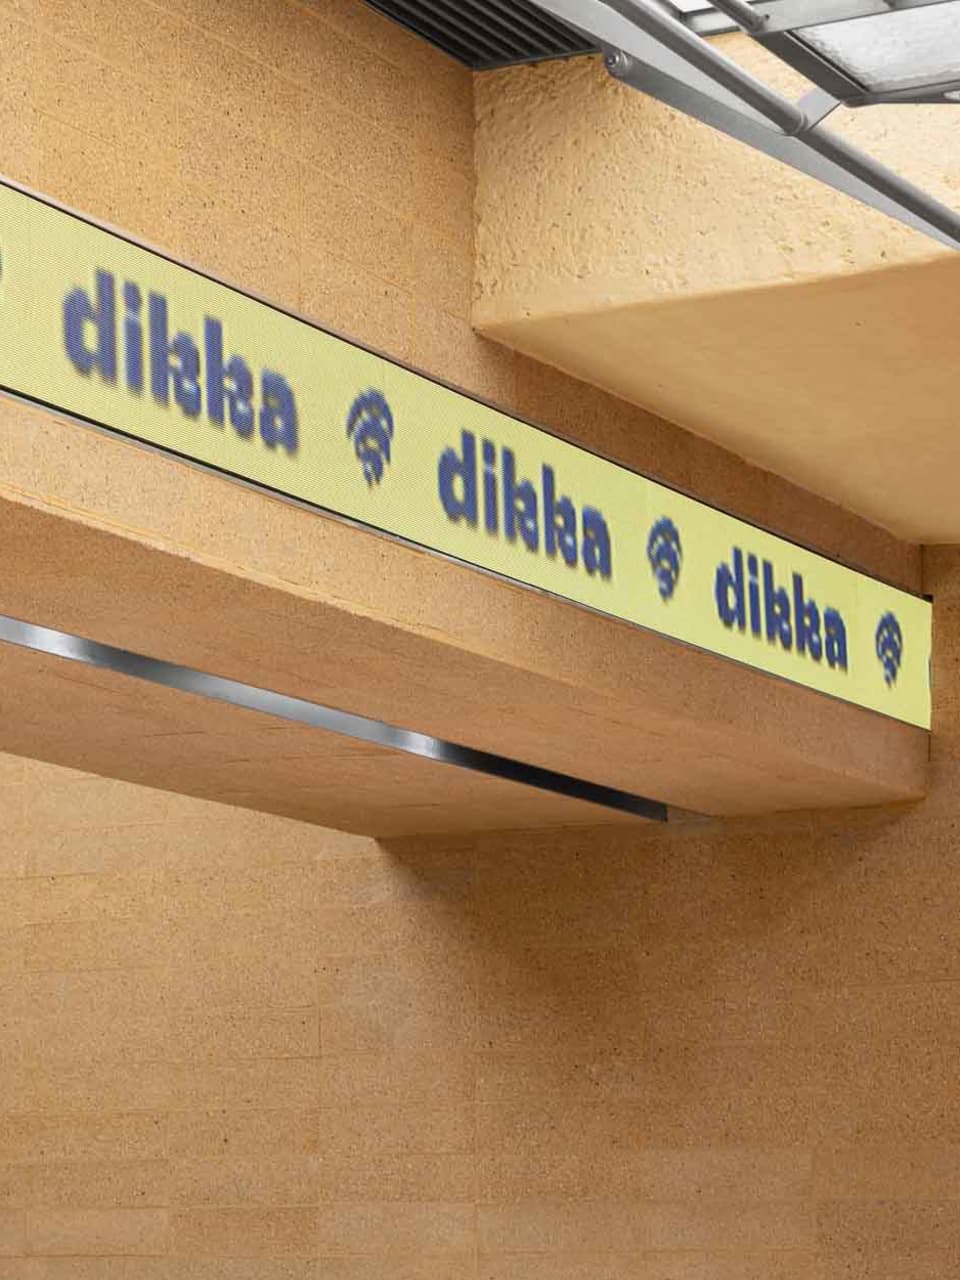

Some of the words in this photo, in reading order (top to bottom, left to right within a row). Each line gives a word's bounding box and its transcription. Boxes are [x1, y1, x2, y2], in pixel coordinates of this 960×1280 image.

[63, 269, 298, 455] dikka
[437, 430, 613, 579] dikka
[714, 547, 849, 669] dikka
